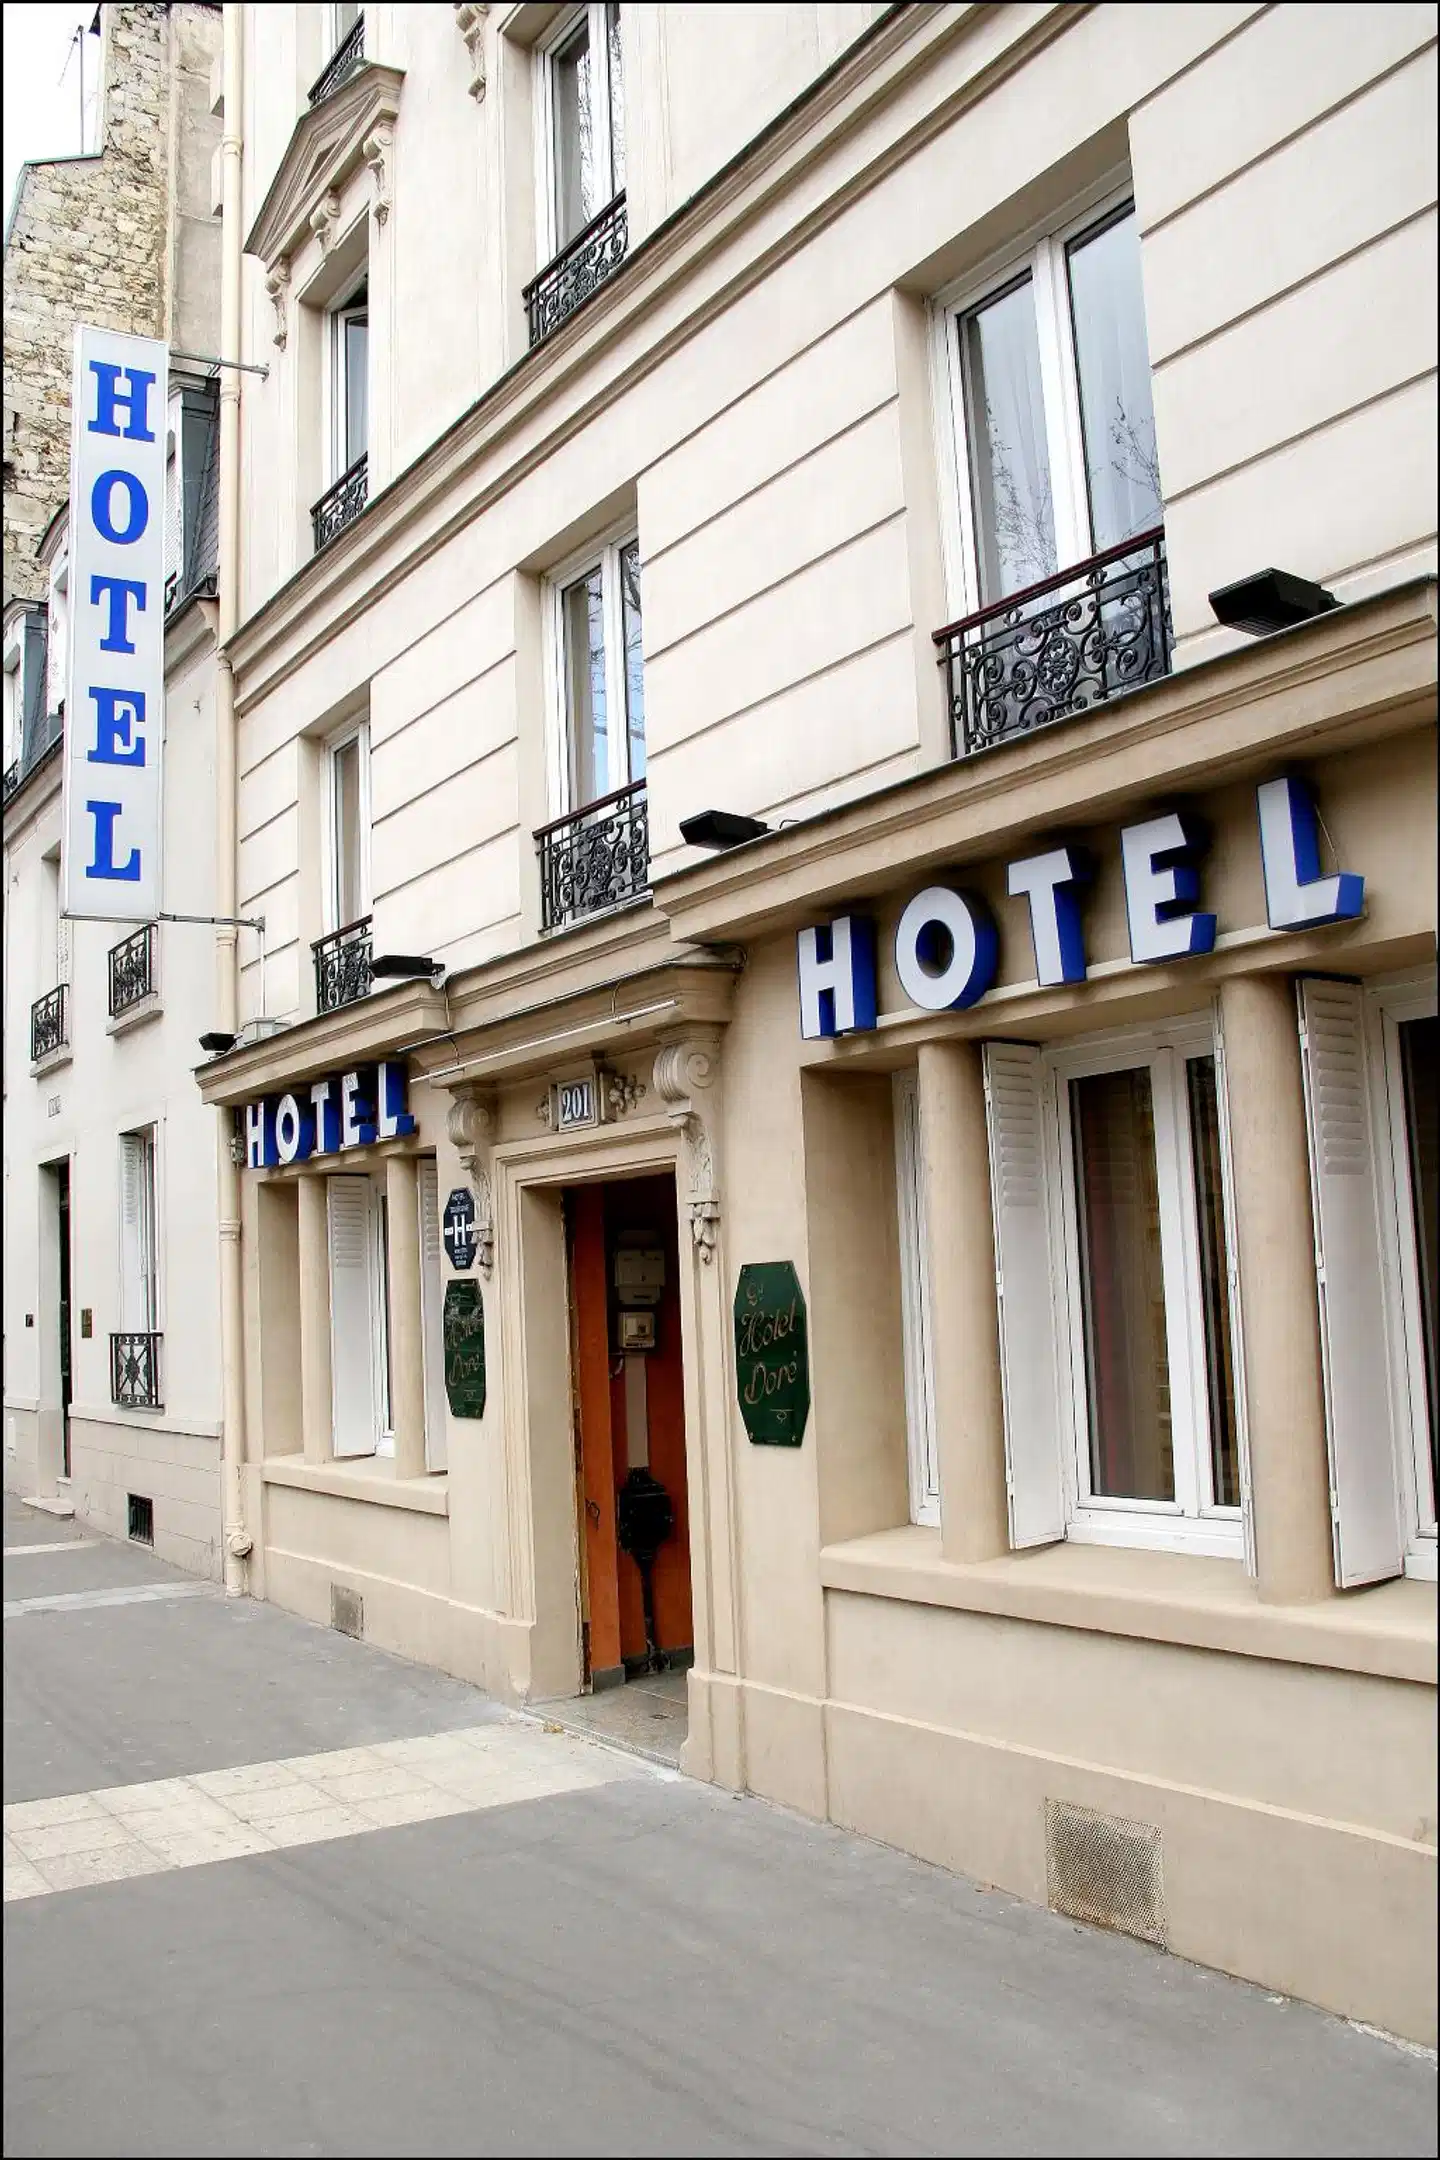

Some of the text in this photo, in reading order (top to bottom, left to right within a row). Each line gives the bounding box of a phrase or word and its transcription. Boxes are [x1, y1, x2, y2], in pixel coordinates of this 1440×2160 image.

[86, 360, 156, 882] HOTEL
[797, 776, 1365, 1041] HOTEL
[246, 1062, 414, 1169] HOTEL
[562, 1084, 589, 1122] 201
[744, 1350, 798, 1405] Doré
